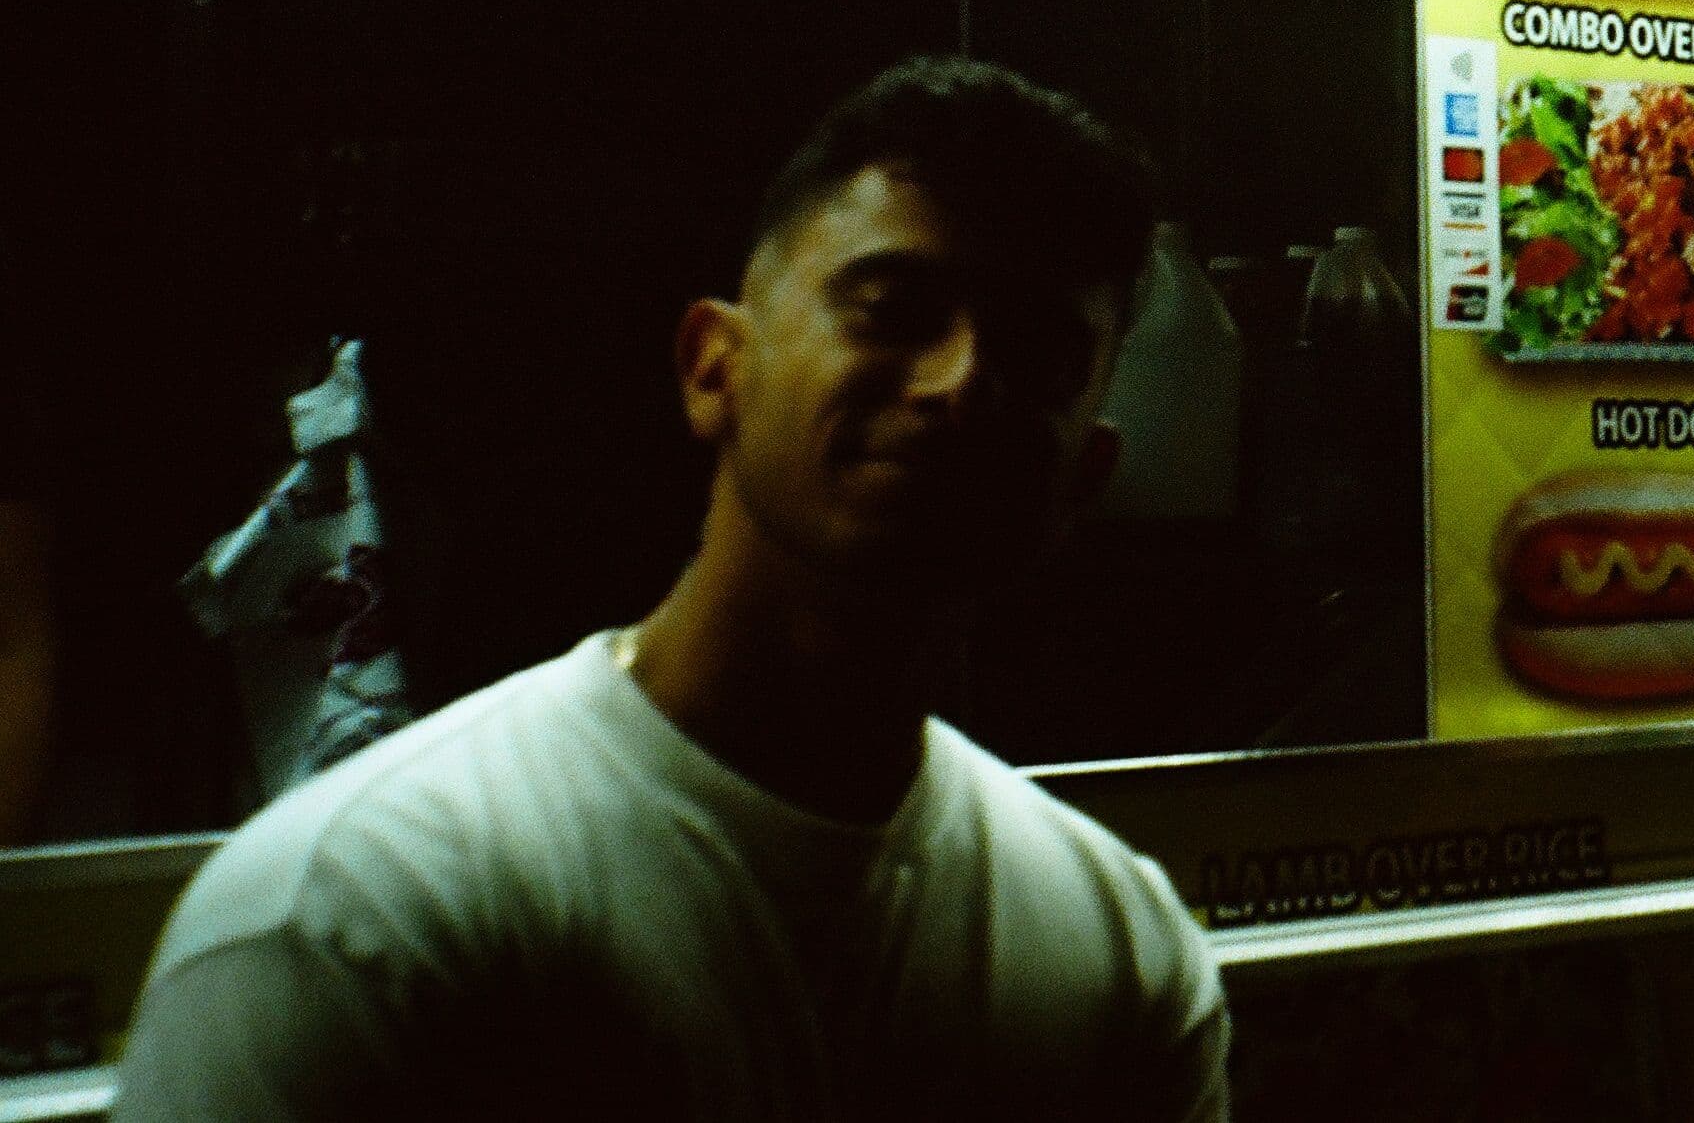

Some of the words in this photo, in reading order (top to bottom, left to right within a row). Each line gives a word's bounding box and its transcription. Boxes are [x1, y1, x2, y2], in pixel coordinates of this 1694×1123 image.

[1502, 1, 1625, 54] COMBO
[1596, 404, 1660, 444] HOT
[1206, 852, 1359, 922] LAMB
[1364, 835, 1490, 904] OVER
[1500, 819, 1604, 885] RICE
